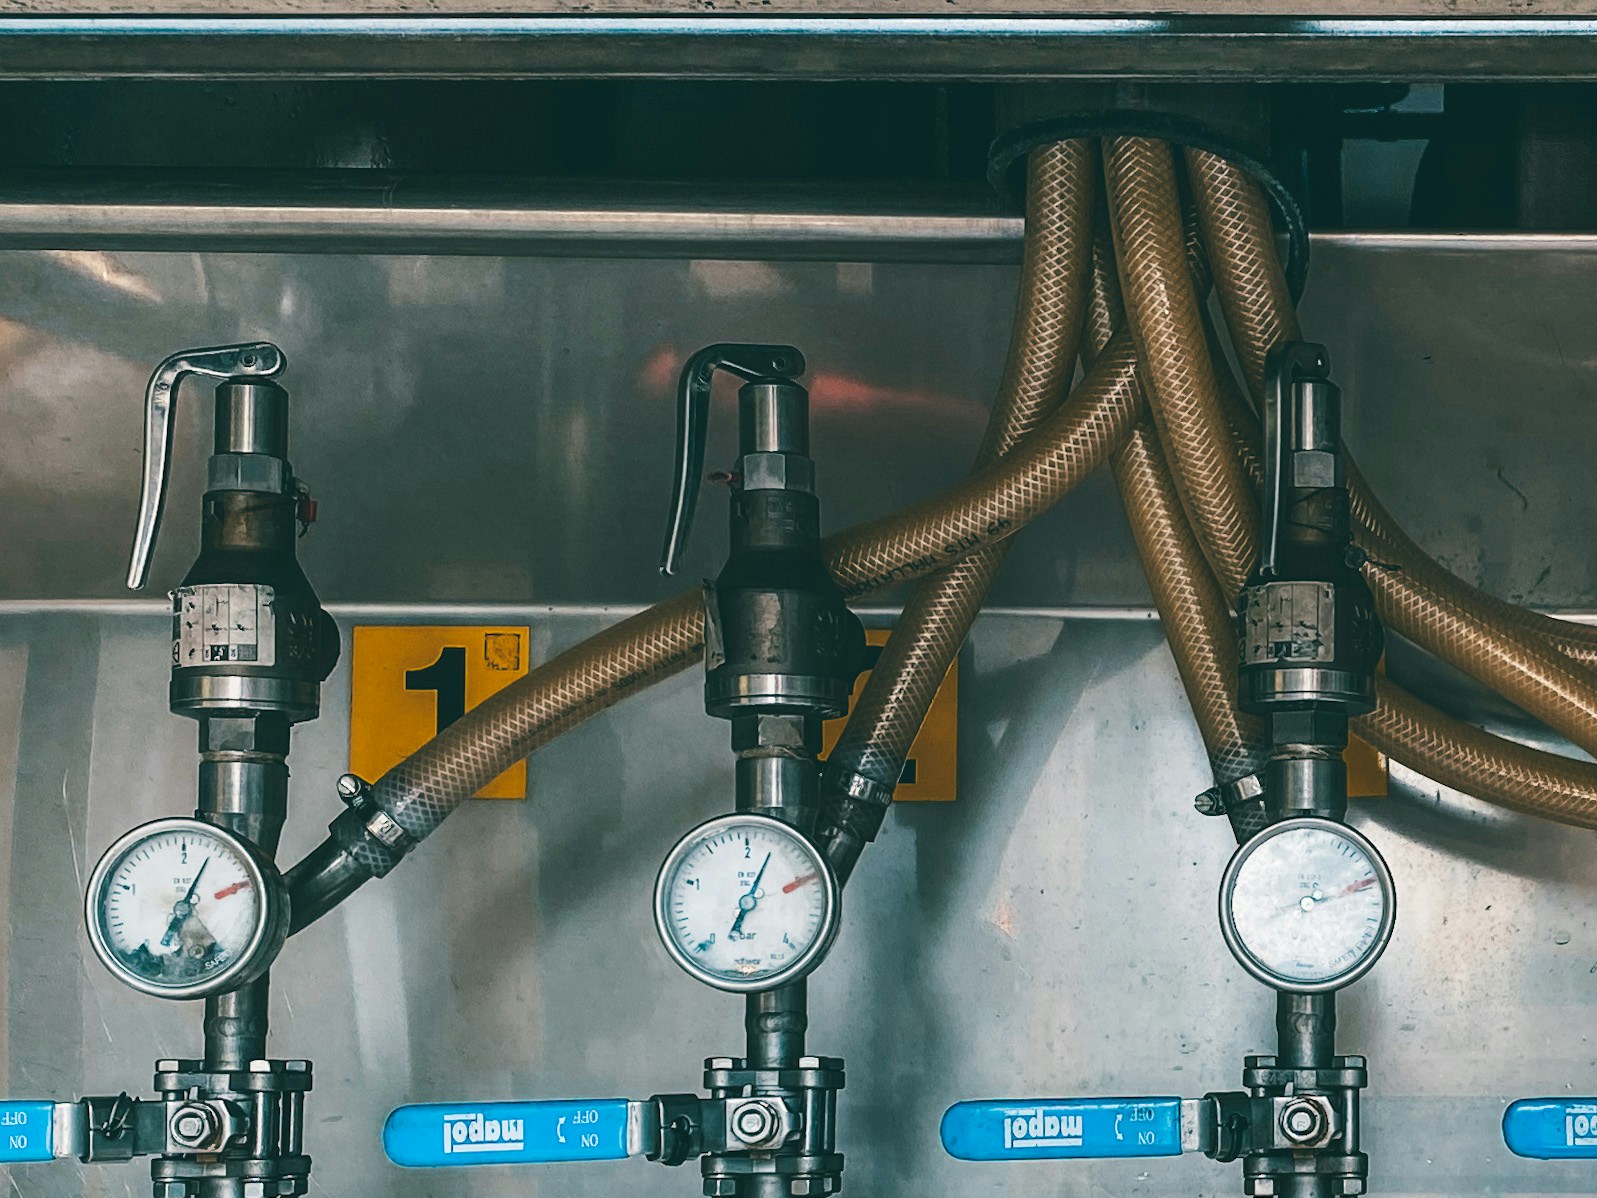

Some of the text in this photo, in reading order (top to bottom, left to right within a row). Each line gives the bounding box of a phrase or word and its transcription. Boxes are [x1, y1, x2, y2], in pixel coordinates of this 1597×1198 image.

[405, 647, 465, 735] 1
[181, 853, 188, 864] 2
[745, 848, 751, 858] 2
[695, 879, 700, 890] 1
[710, 934, 716, 944] 0
[1, 1112, 27, 1126] OFF
[573, 1110, 598, 1124] OFF
[1129, 1108, 1155, 1121] OFF
[444, 1113, 524, 1153] mapol
[1004, 1109, 1083, 1148] mapol
[10, 1135, 27, 1149] ON
[581, 1134, 598, 1148] ON
[1138, 1131, 1155, 1145] ON
